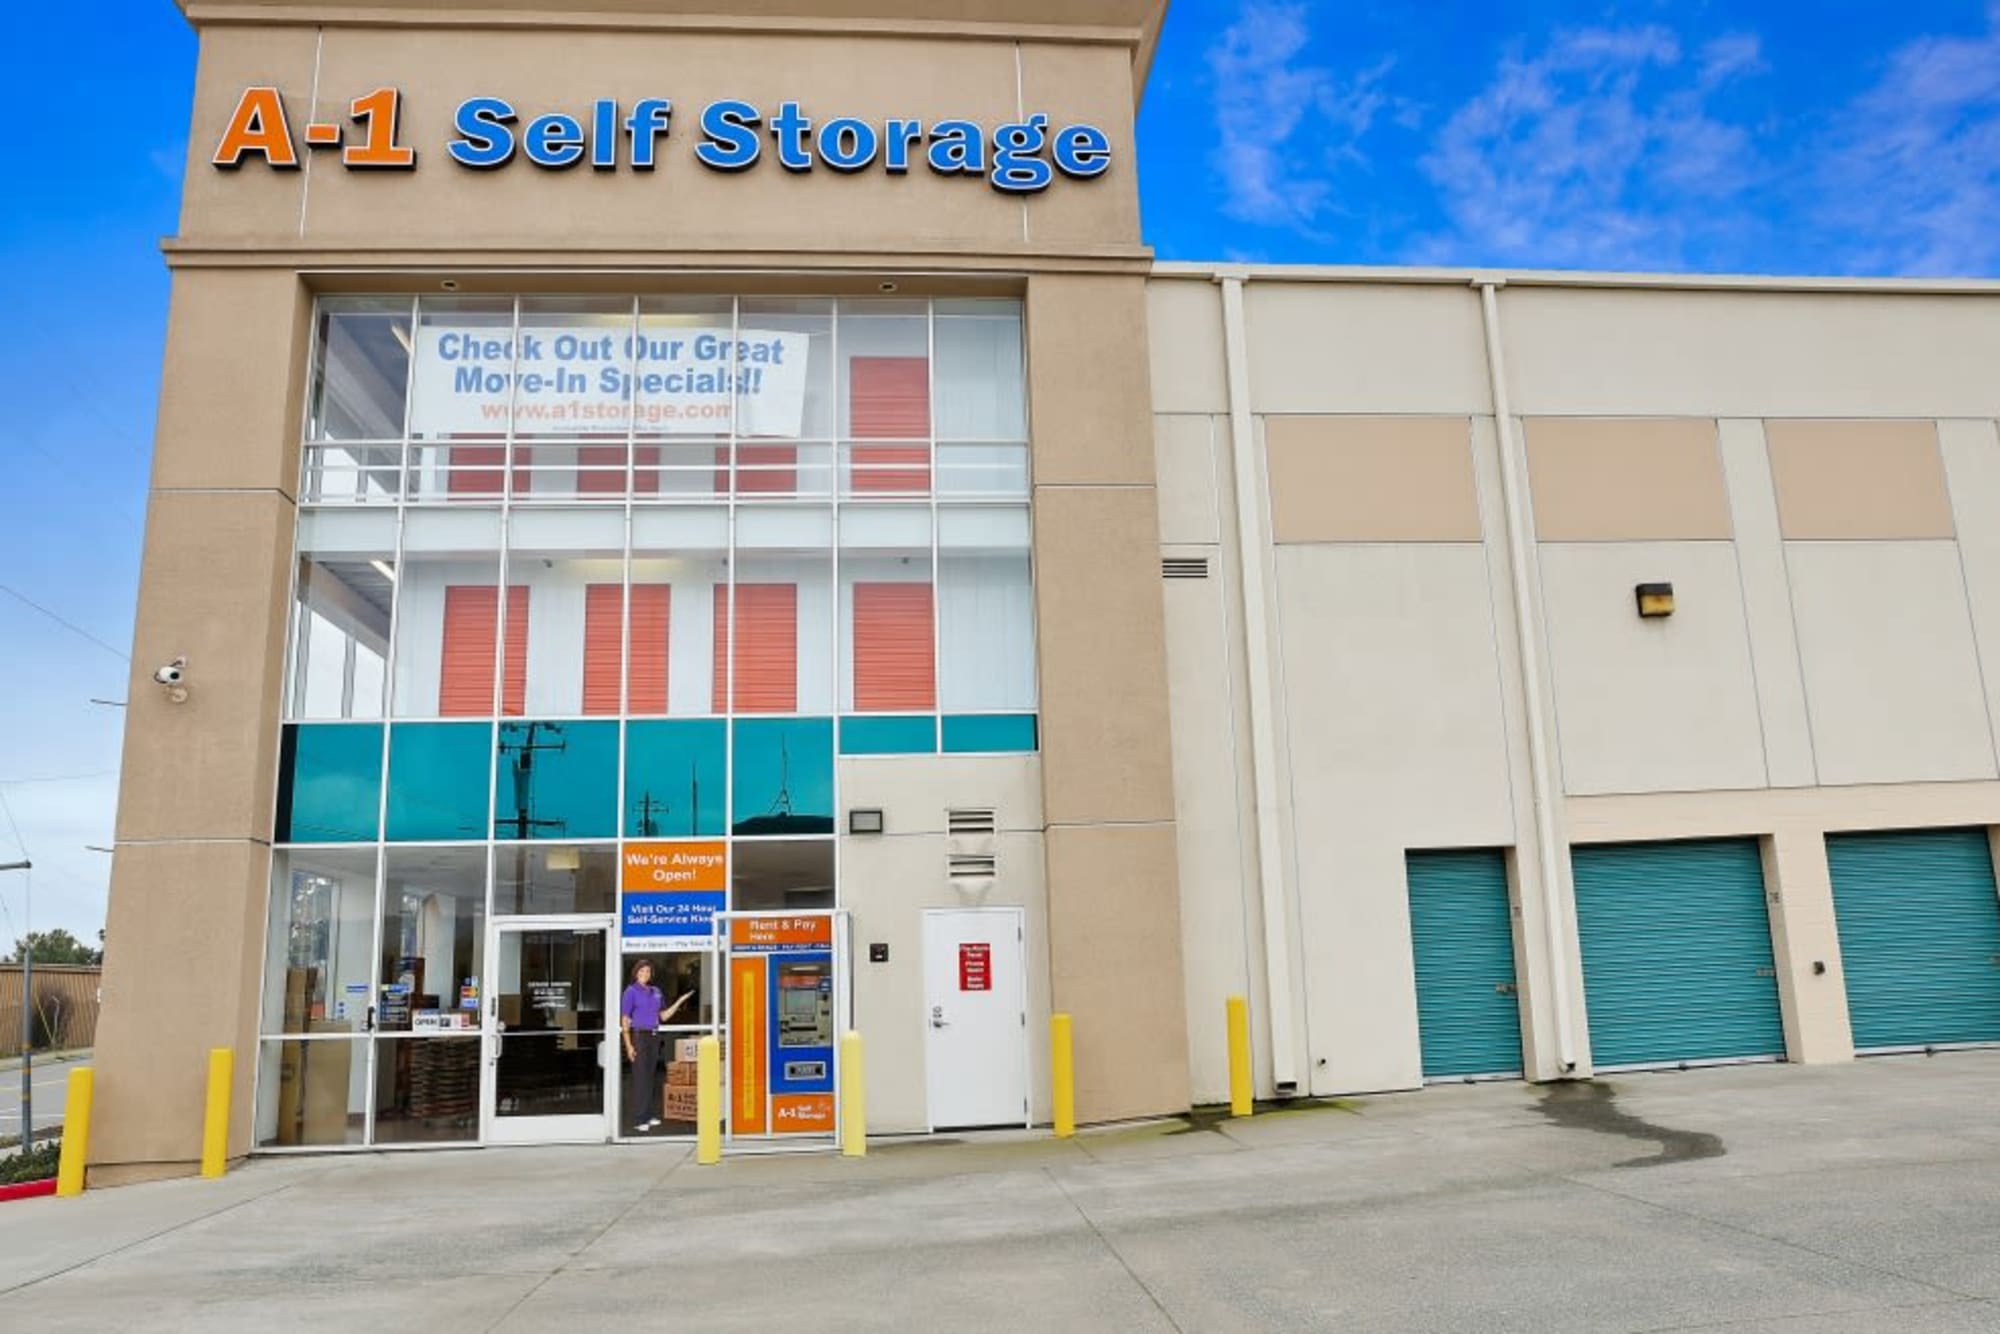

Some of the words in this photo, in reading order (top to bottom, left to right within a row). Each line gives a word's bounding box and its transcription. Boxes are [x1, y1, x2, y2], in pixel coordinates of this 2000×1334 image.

[212, 86, 418, 171] A-1
[448, 96, 673, 171] Self
[694, 99, 1112, 194] Storage
[554, 335, 613, 361] Out
[624, 334, 684, 361] Our
[694, 334, 784, 365] Great
[454, 366, 587, 394] Move-In
[626, 853, 668, 866] We're
[671, 852, 724, 868] Always
[653, 867, 697, 883] Open!
[631, 904, 654, 914] Visit
[656, 904, 675, 914] Our
[677, 904, 690, 914] 24
[627, 914, 688, 924] Self-Service
[749, 919, 778, 931] Rent
[793, 918, 817, 933] Pay
